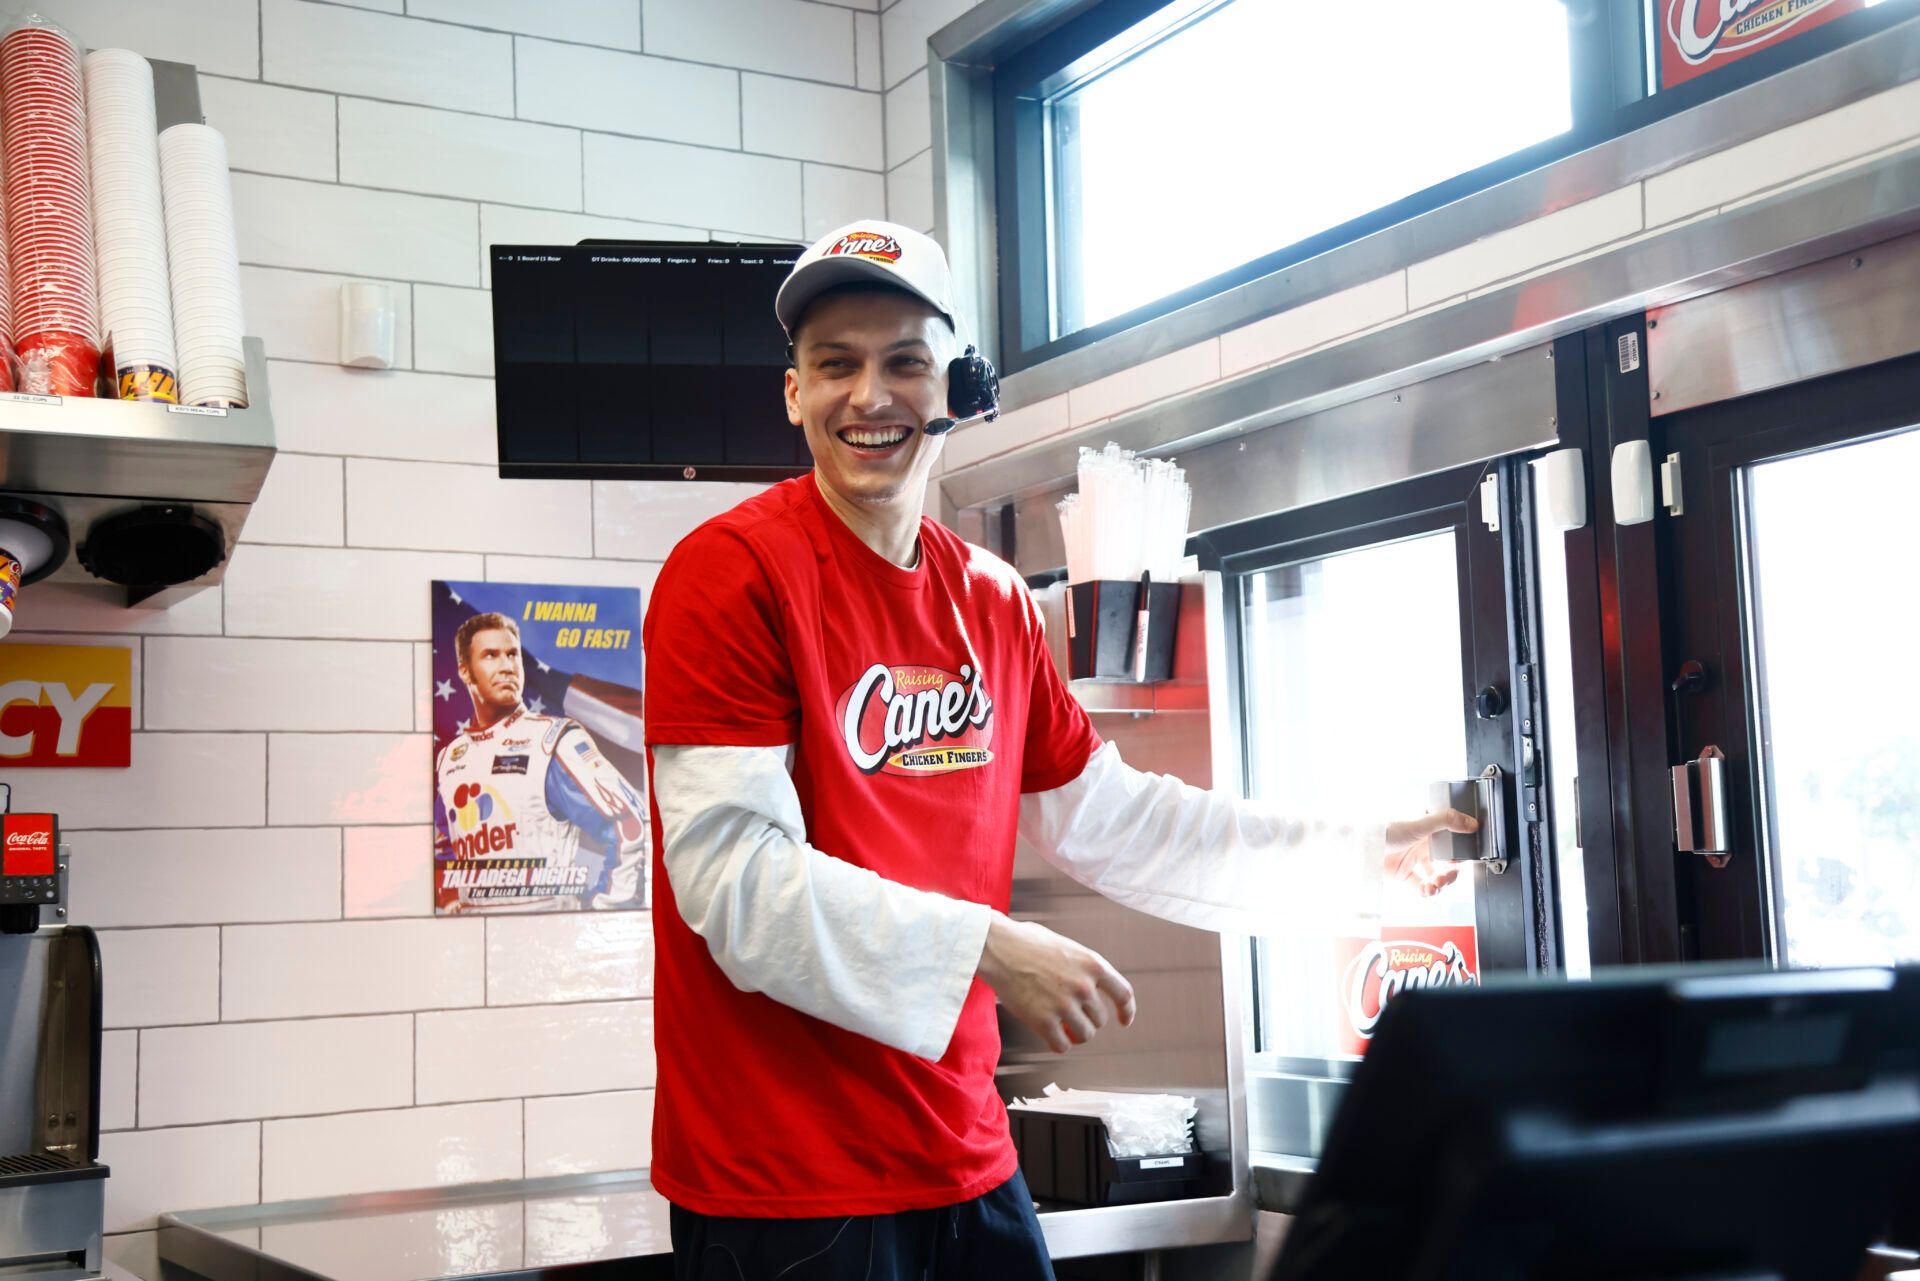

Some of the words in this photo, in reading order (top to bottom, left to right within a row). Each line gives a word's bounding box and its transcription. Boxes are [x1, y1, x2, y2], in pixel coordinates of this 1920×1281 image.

[1736, 8, 1783, 35] CHICKEN
[523, 600, 533, 621] I
[534, 601, 598, 622] WANNA
[555, 627, 581, 648] GO
[582, 629, 631, 650] FAST!
[895, 669, 944, 690] Raising
[844, 664, 992, 774] Cane's
[902, 751, 944, 767] CHICKEN
[946, 750, 987, 764] FINGERS
[6, 831, 51, 846] Coca-Cola
[446, 860, 477, 870] WILL
[486, 859, 545, 870] FERRELL
[442, 867, 528, 889] TALLADEGA
[530, 866, 588, 887] NIGHTS
[1390, 948, 1433, 967] Raising
